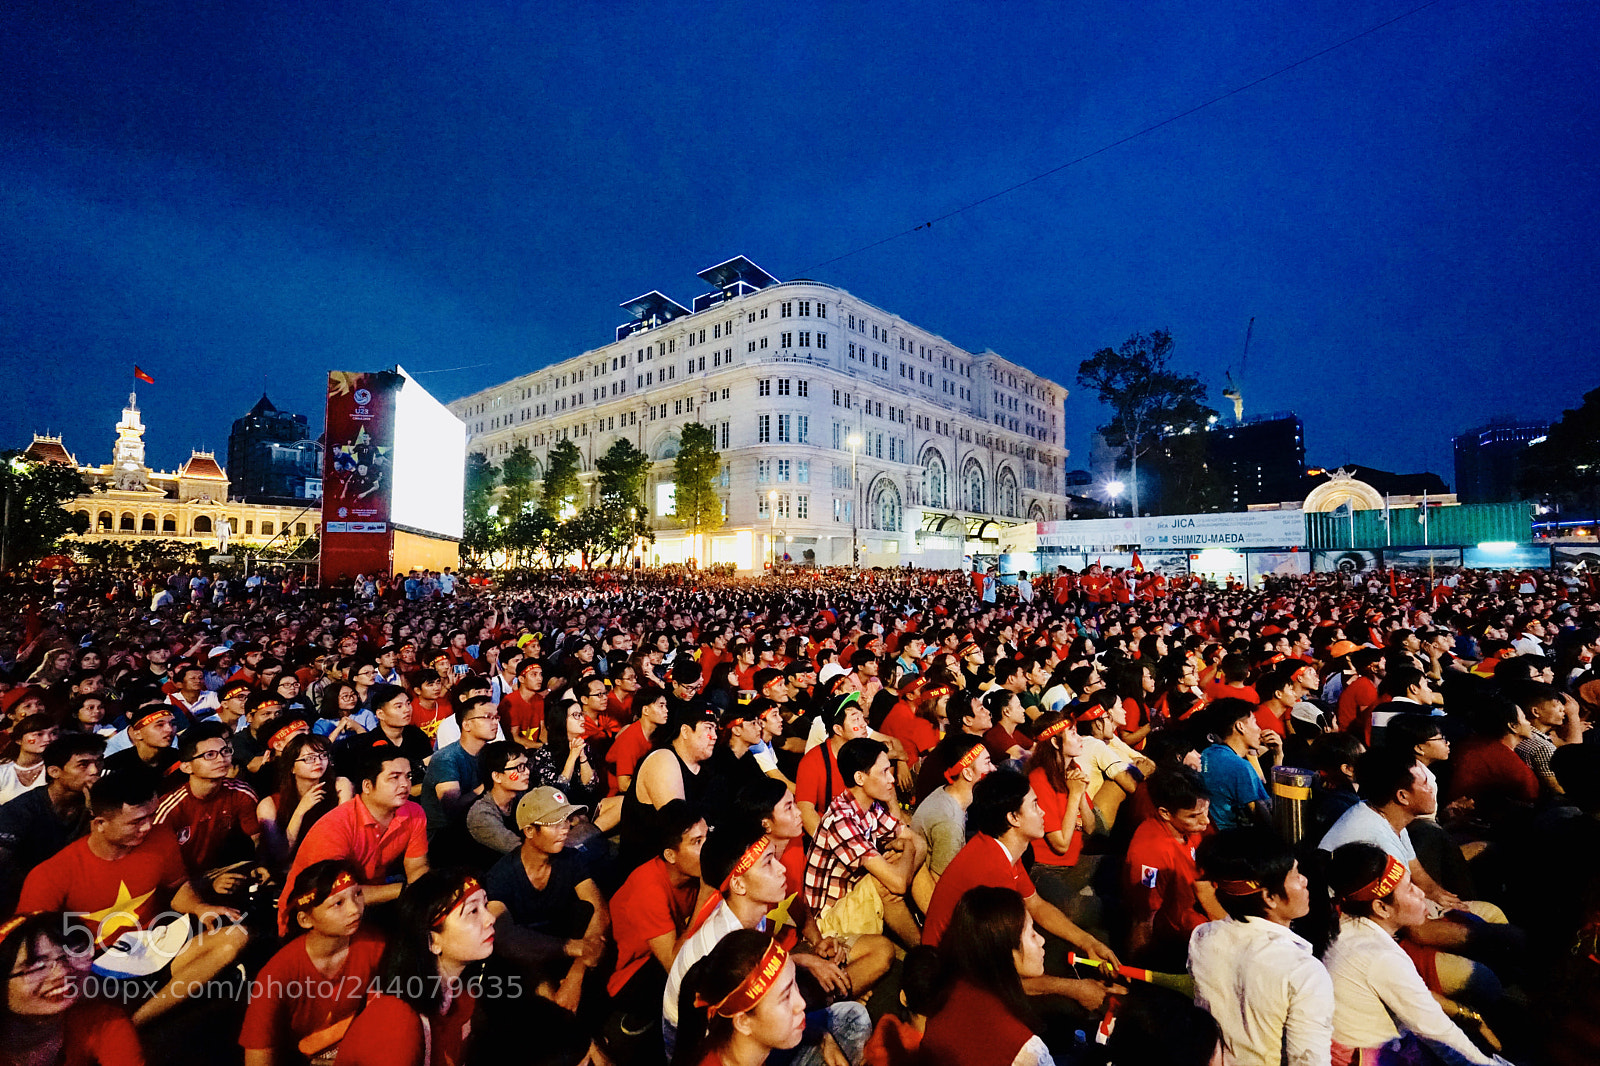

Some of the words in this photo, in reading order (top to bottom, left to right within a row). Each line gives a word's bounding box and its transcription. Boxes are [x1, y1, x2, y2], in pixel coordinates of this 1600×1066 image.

[1171, 518, 1196, 528] JICA
[1039, 536, 1086, 545] VIETNAM
[1099, 533, 1138, 545] JAPAN
[1172, 533, 1245, 545] SHIMIZU-MAEDA
[1387, 862, 1404, 883] NAM
[762, 955, 782, 981] NAM
